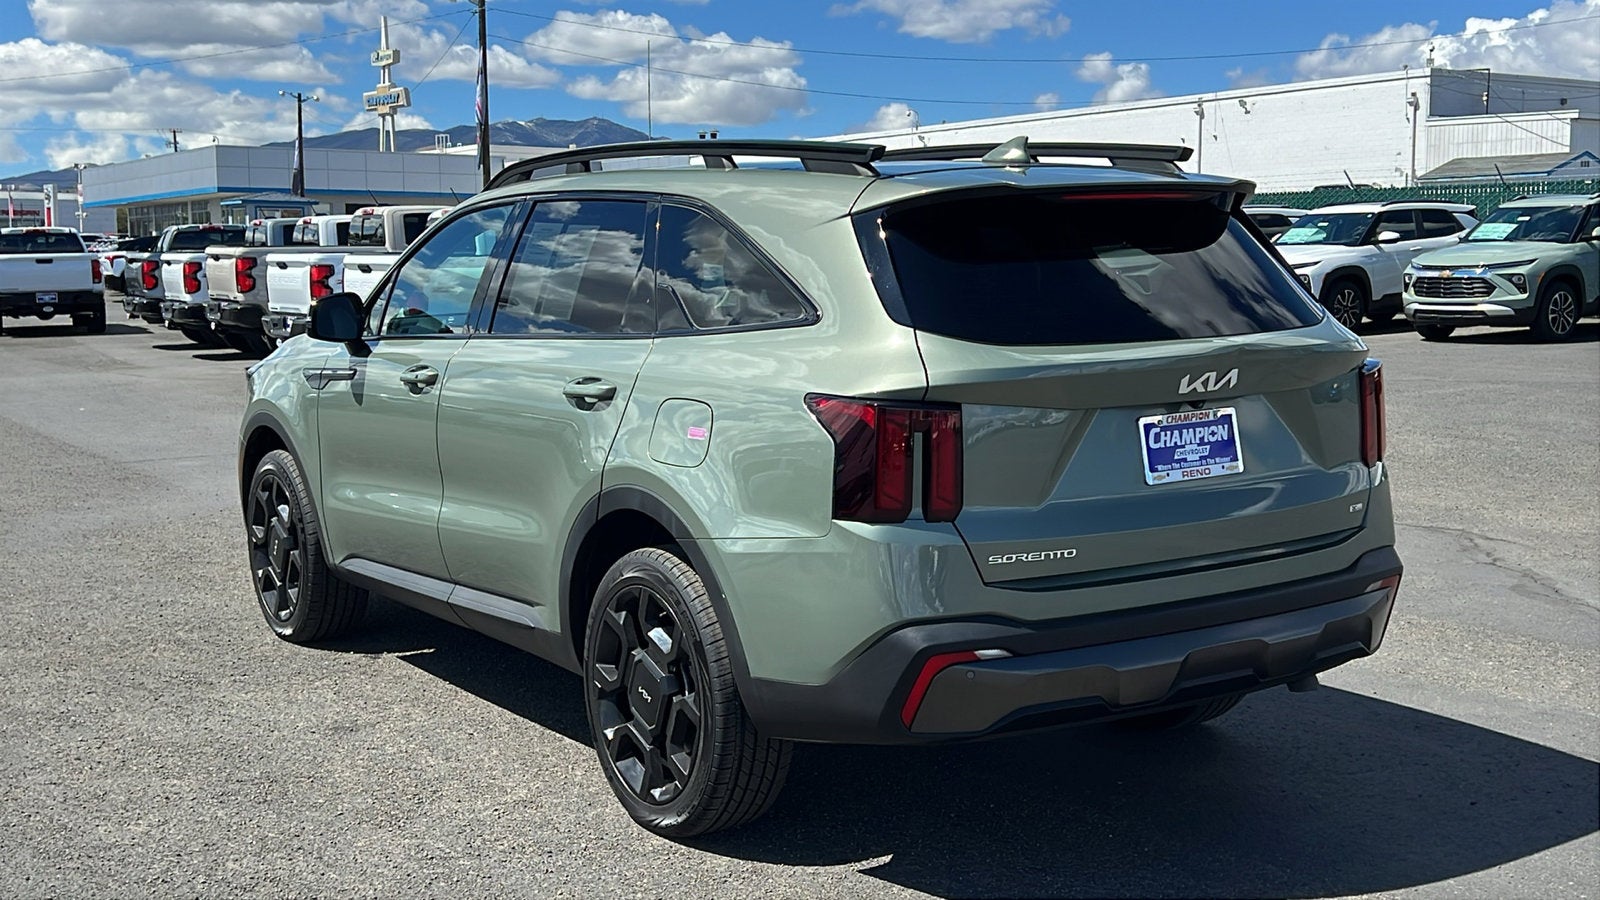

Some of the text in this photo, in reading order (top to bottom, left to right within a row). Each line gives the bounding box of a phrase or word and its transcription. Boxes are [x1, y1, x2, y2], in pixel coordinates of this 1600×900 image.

[1178, 368, 1239, 394] KIA
[1166, 411, 1210, 424] CHAMPION
[1149, 425, 1228, 449] CHAMPION
[1176, 447, 1208, 457] CHEVROLET
[1182, 468, 1211, 478] RENO
[988, 549, 1076, 564] SORENTO
